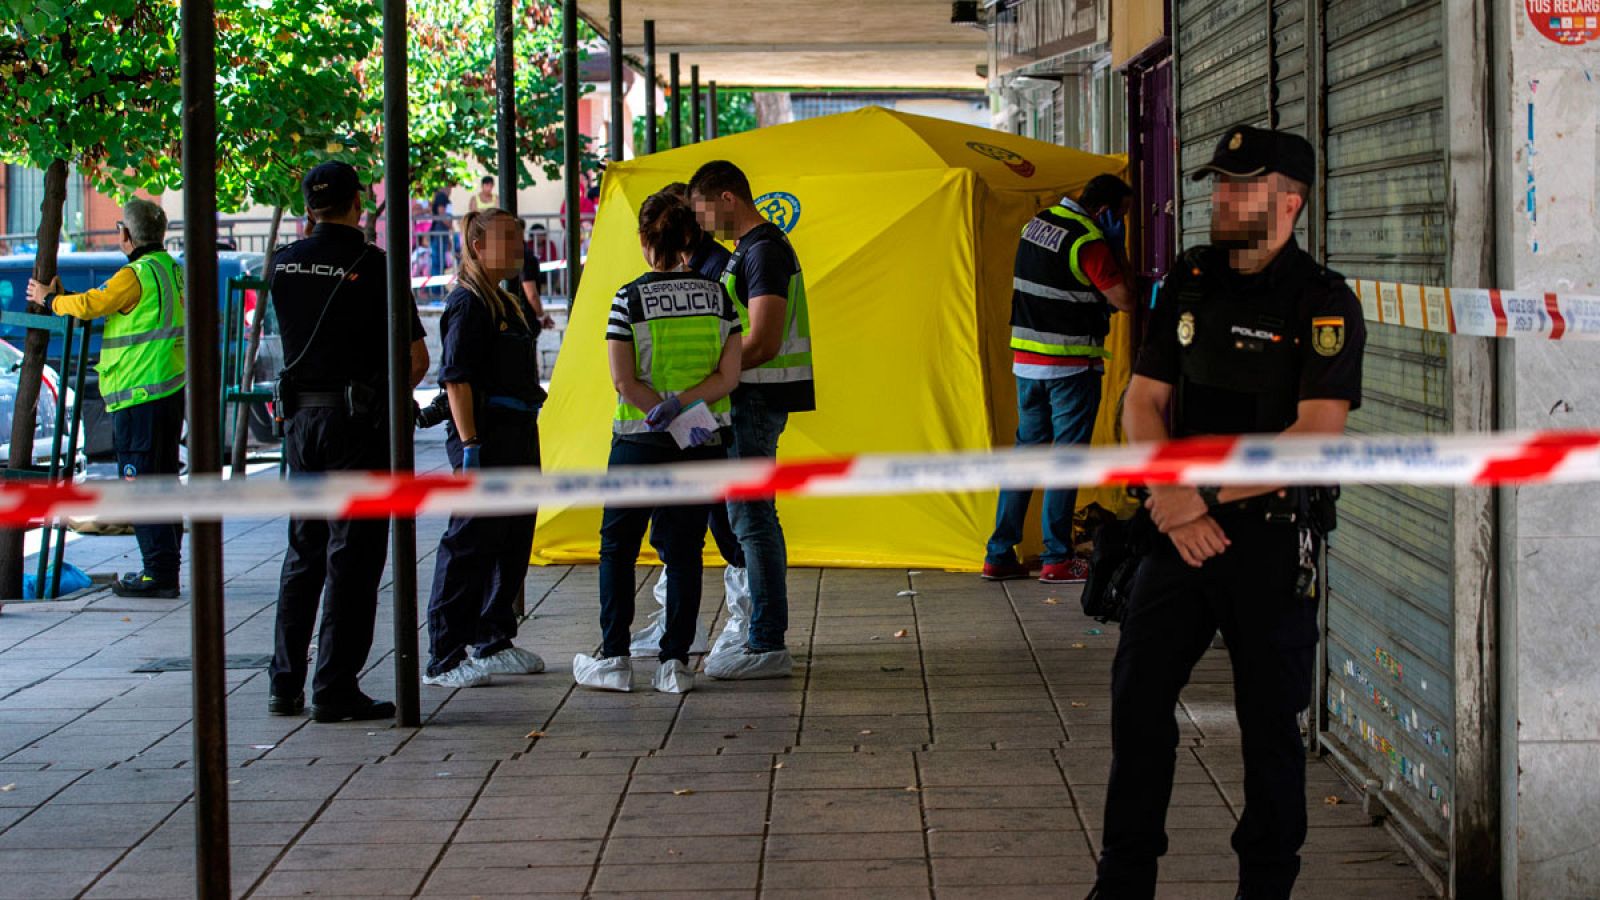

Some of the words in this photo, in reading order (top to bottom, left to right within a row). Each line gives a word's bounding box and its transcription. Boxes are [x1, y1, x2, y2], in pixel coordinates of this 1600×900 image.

[1529, 0, 1550, 13] TUS
[1025, 219, 1063, 250] POLICIA
[275, 263, 345, 277] POLICIA
[674, 281, 709, 292] NACIONAL
[644, 292, 720, 314] POLICIA
[1231, 325, 1273, 340] POLICIA
